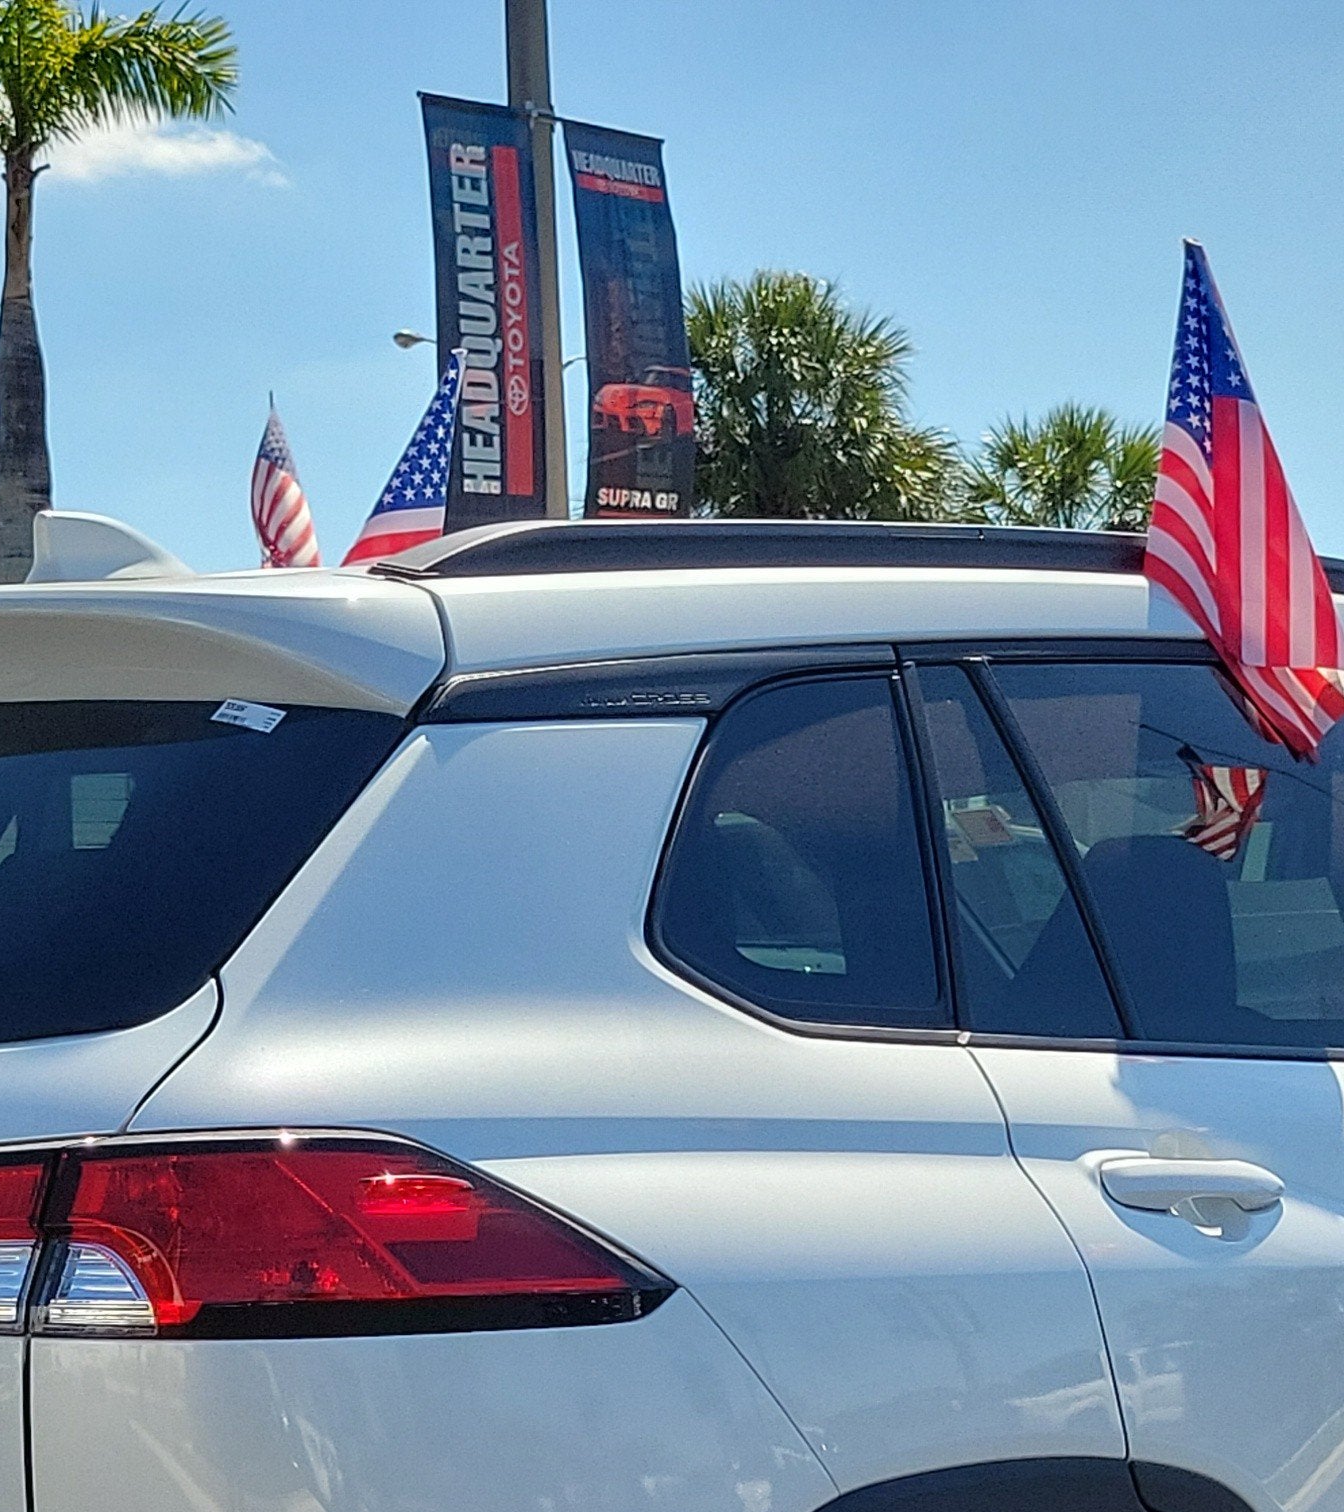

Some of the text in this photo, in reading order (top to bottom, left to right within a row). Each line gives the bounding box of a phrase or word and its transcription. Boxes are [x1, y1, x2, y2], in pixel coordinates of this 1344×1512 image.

[571, 149, 661, 187] HEADQUARTER
[450, 143, 503, 494] HEADQUARTER
[502, 240, 528, 372] TOYOTA
[597, 487, 679, 511] SUPRA GR
